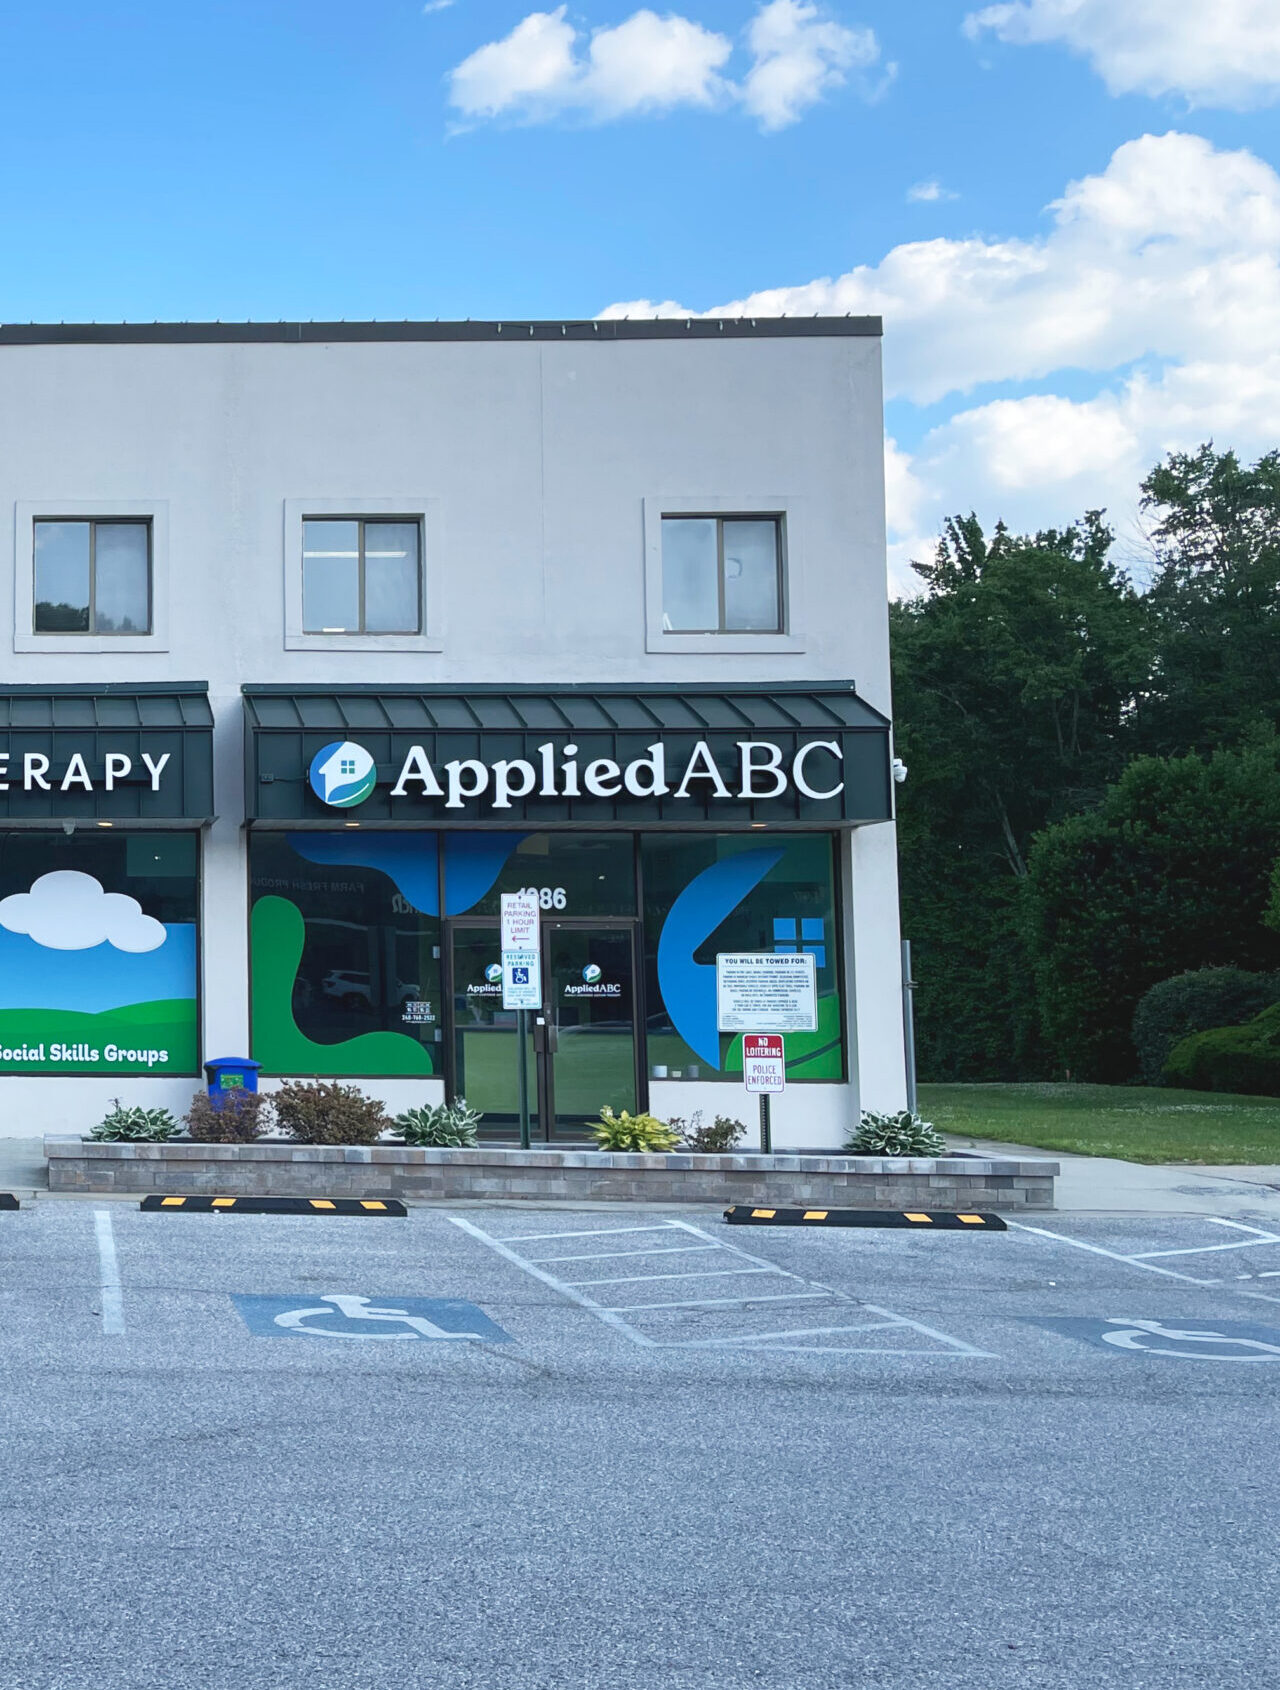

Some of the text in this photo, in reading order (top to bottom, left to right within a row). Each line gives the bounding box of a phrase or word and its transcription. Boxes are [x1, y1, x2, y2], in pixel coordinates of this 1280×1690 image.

[390, 740, 844, 808] AppliedABC
[504, 910, 537, 918] PARKING
[564, 983, 621, 994] AppliedABC
[758, 1037, 769, 1047] NO
[49, 1043, 100, 1062] Skills
[103, 1044, 169, 1067] Groups
[746, 1047, 782, 1057] LOITERING
[752, 1064, 776, 1075] POLICE
[747, 1075, 782, 1085] ENFORCED
